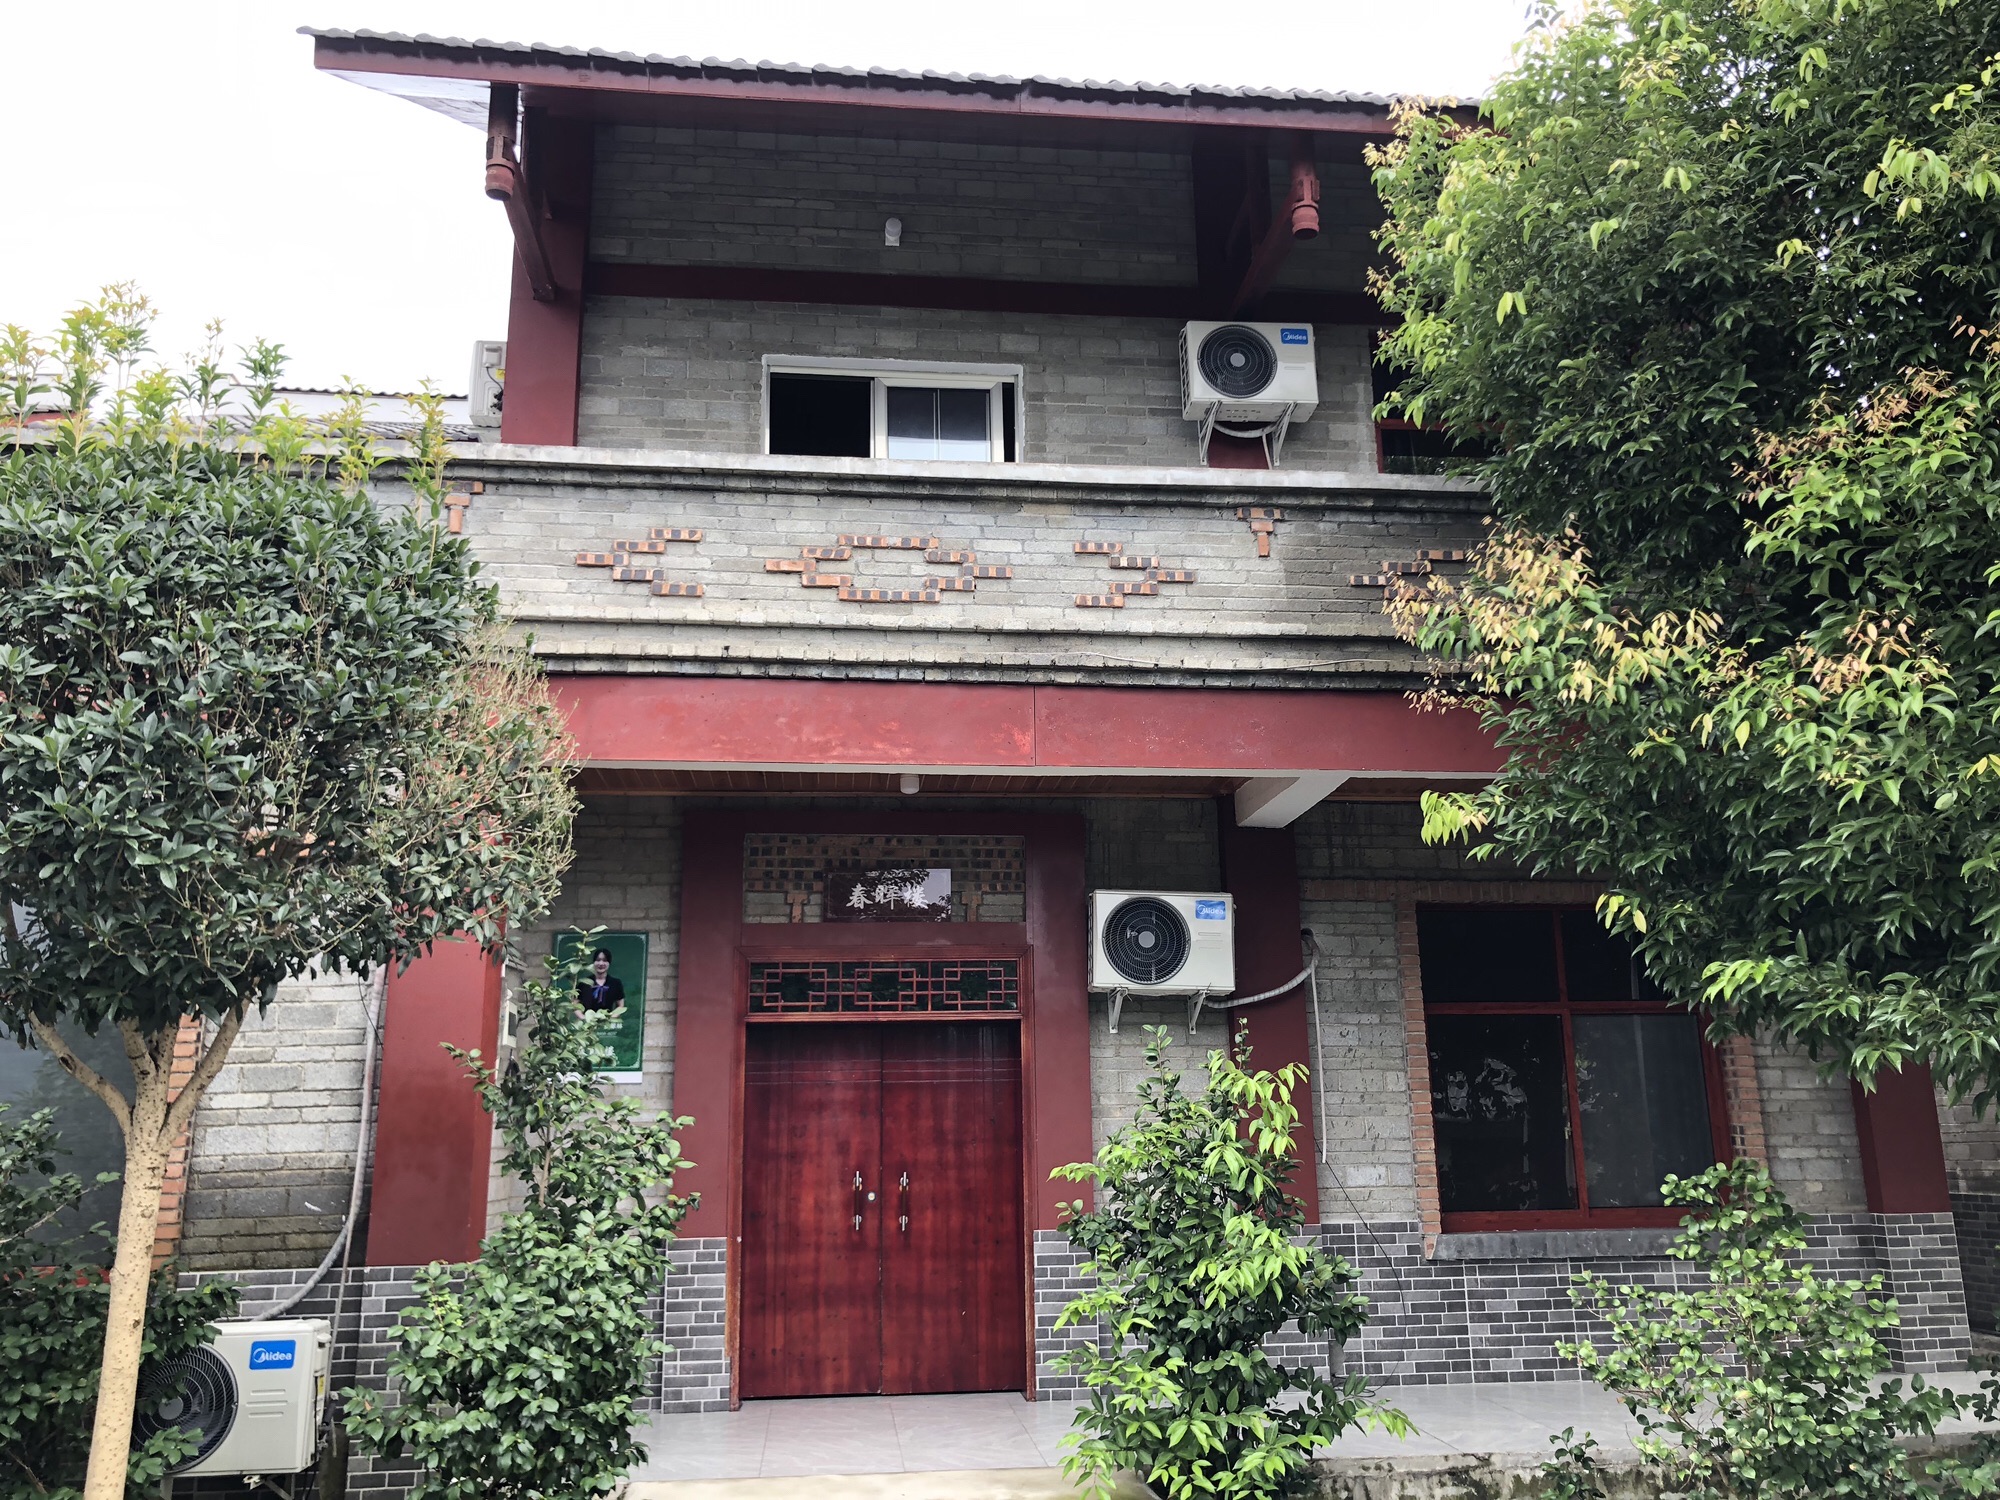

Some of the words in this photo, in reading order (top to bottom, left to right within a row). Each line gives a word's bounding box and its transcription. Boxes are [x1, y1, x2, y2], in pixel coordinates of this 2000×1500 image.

[1283, 331, 1307, 341] Midea
[1197, 904, 1224, 915] Midea
[253, 1347, 292, 1363] Midea
